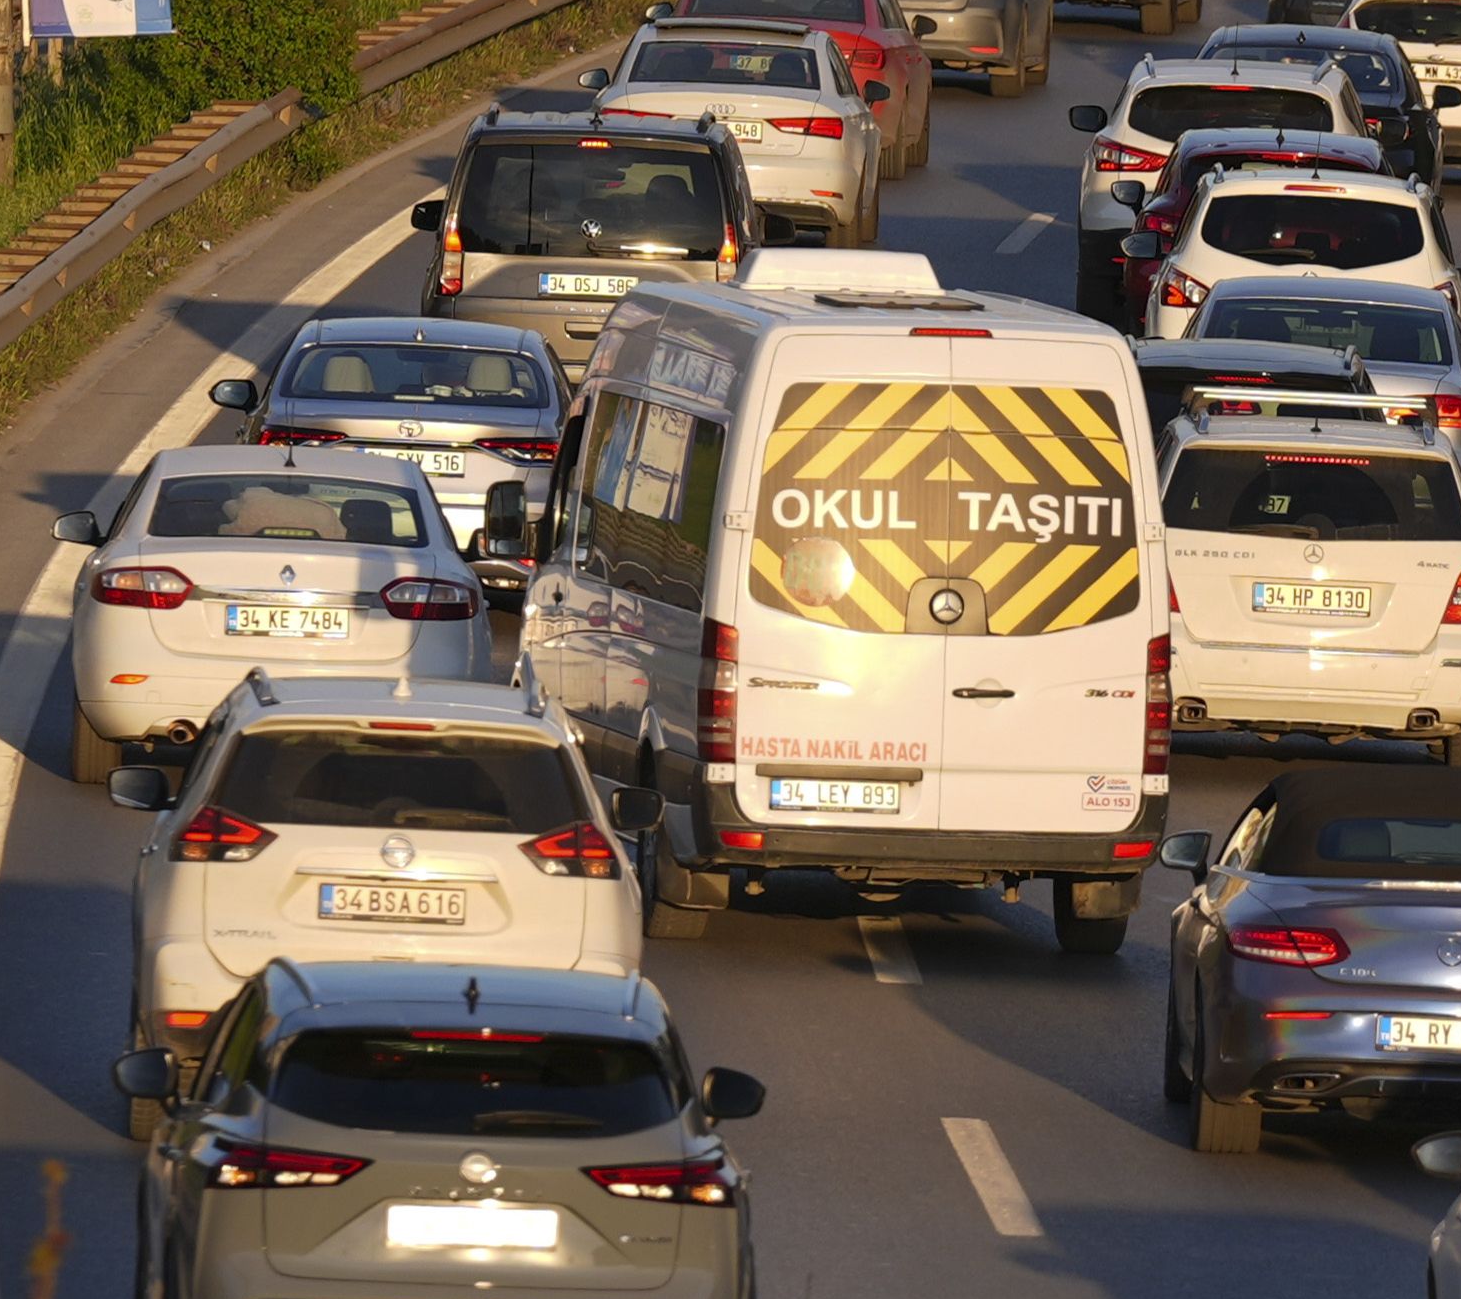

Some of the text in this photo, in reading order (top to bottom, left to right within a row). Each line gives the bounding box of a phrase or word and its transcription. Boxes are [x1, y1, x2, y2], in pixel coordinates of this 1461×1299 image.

[735, 124, 758, 137] 948
[549, 276, 566, 292] 34
[608, 279, 634, 295] 586
[434, 455, 460, 471] 516
[772, 489, 1122, 543] OKUL TAŞITI
[1265, 587, 1365, 609] 34 HP 8130
[239, 609, 343, 631] 34 KE 7484
[1085, 688, 1136, 699] 316 CDI
[741, 736, 800, 757] HASTA
[869, 740, 927, 763] ARACI
[781, 782, 896, 807] 34 LEY 893
[1086, 796, 1131, 808] ALO 153
[335, 884, 460, 916] 34 BSA 616
[1392, 1020, 1417, 1043] 34
[1427, 1022, 1452, 1045] RY
